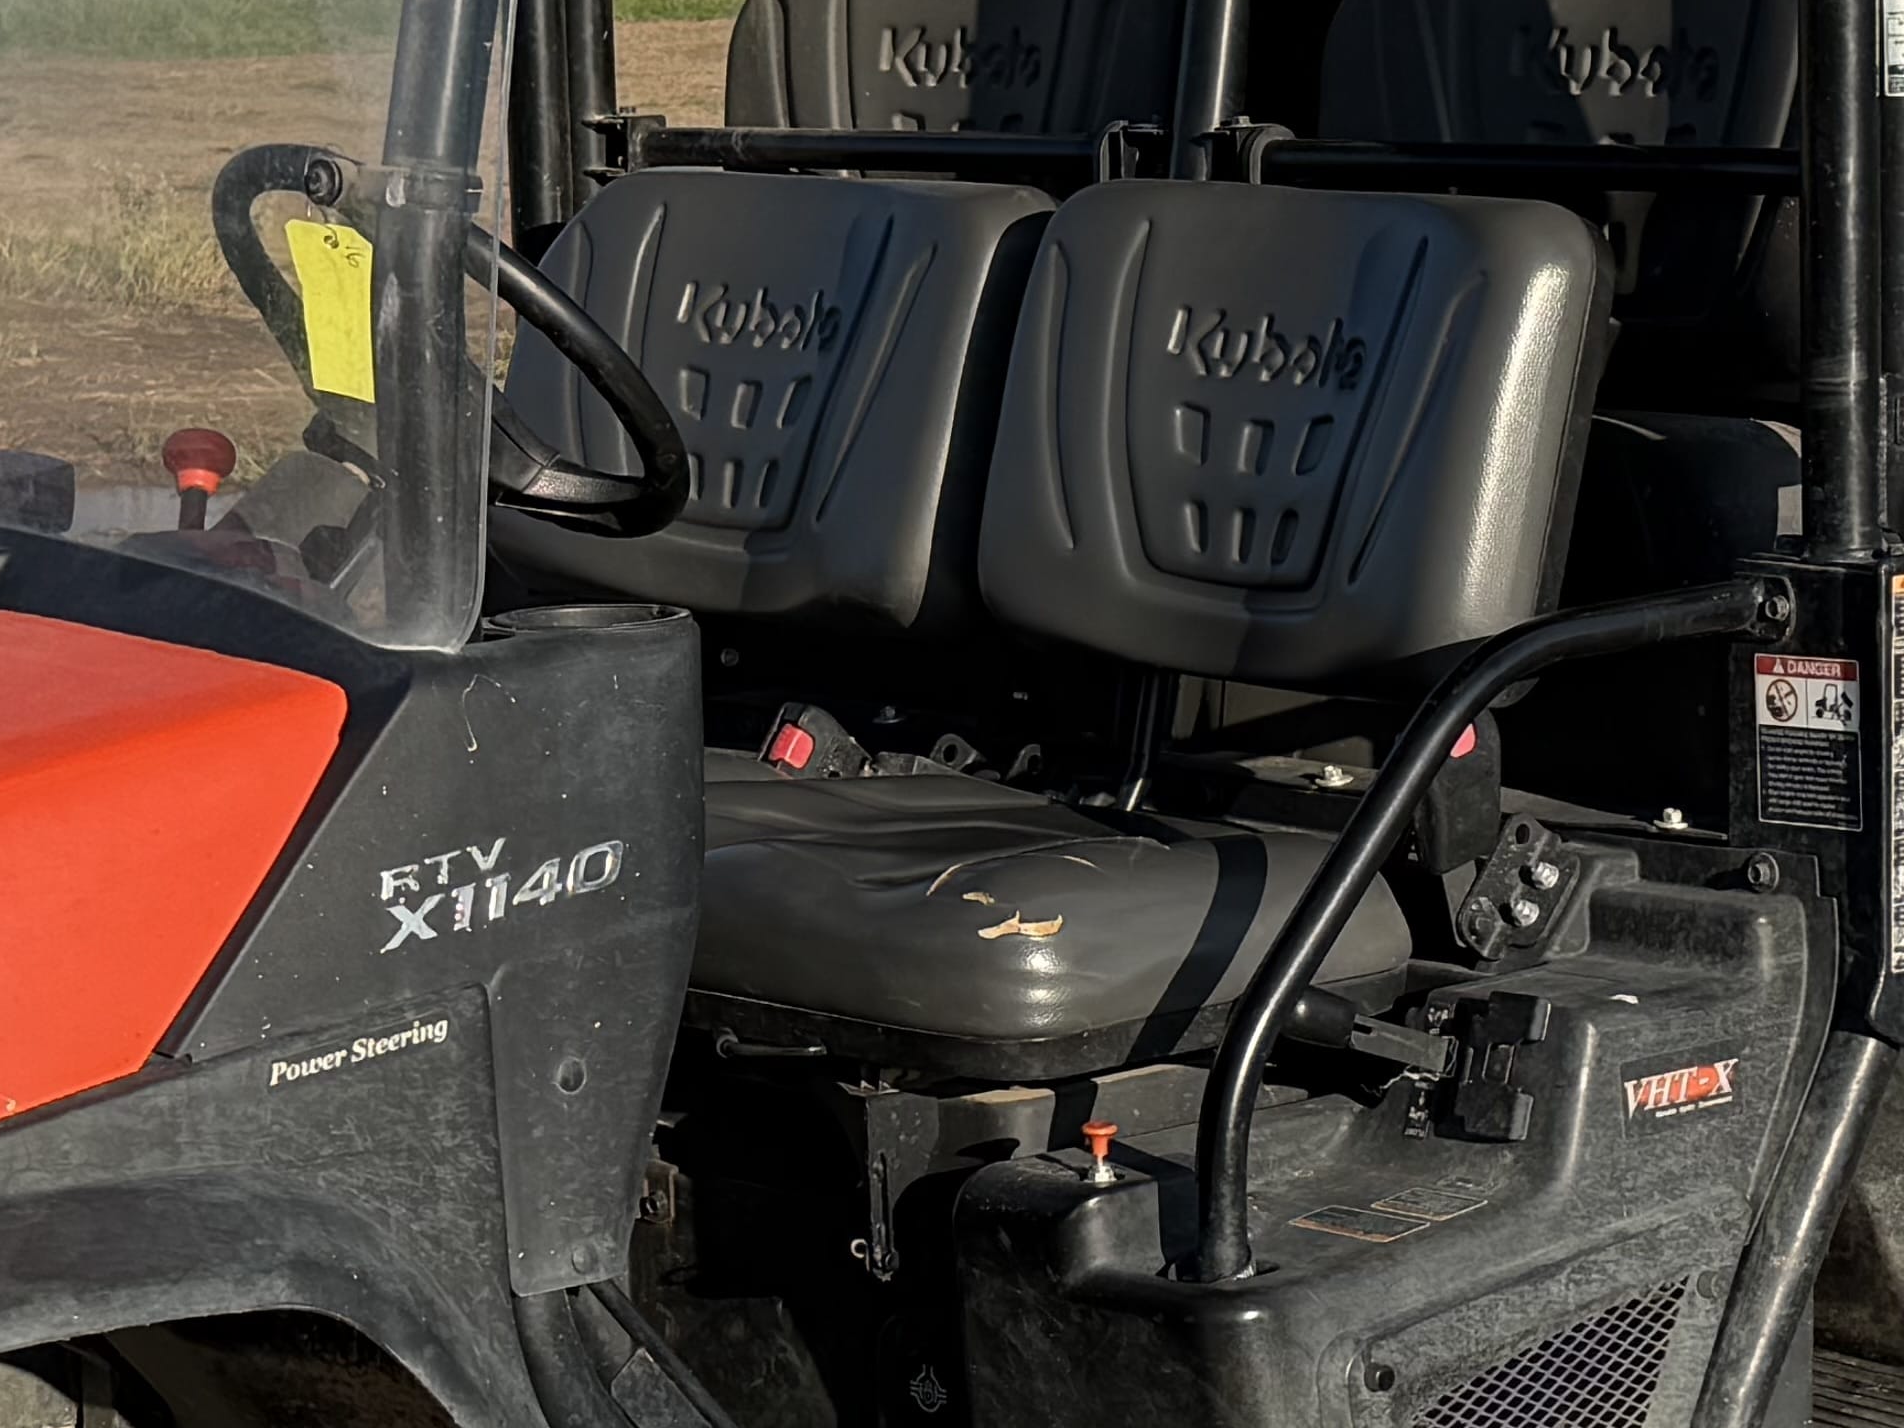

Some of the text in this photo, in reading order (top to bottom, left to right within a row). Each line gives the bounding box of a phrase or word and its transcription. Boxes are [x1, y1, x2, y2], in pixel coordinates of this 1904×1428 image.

[878, 25, 1042, 90] Kubota
[676, 280, 844, 354] Kubota
[1165, 304, 1368, 392] Kubota
[1787, 659, 1842, 678] DANGER
[380, 837, 507, 902] RTV
[380, 840, 625, 955] X1140
[269, 1019, 449, 1088] Power Steering
[1623, 1058, 1740, 1120] VHT-X
